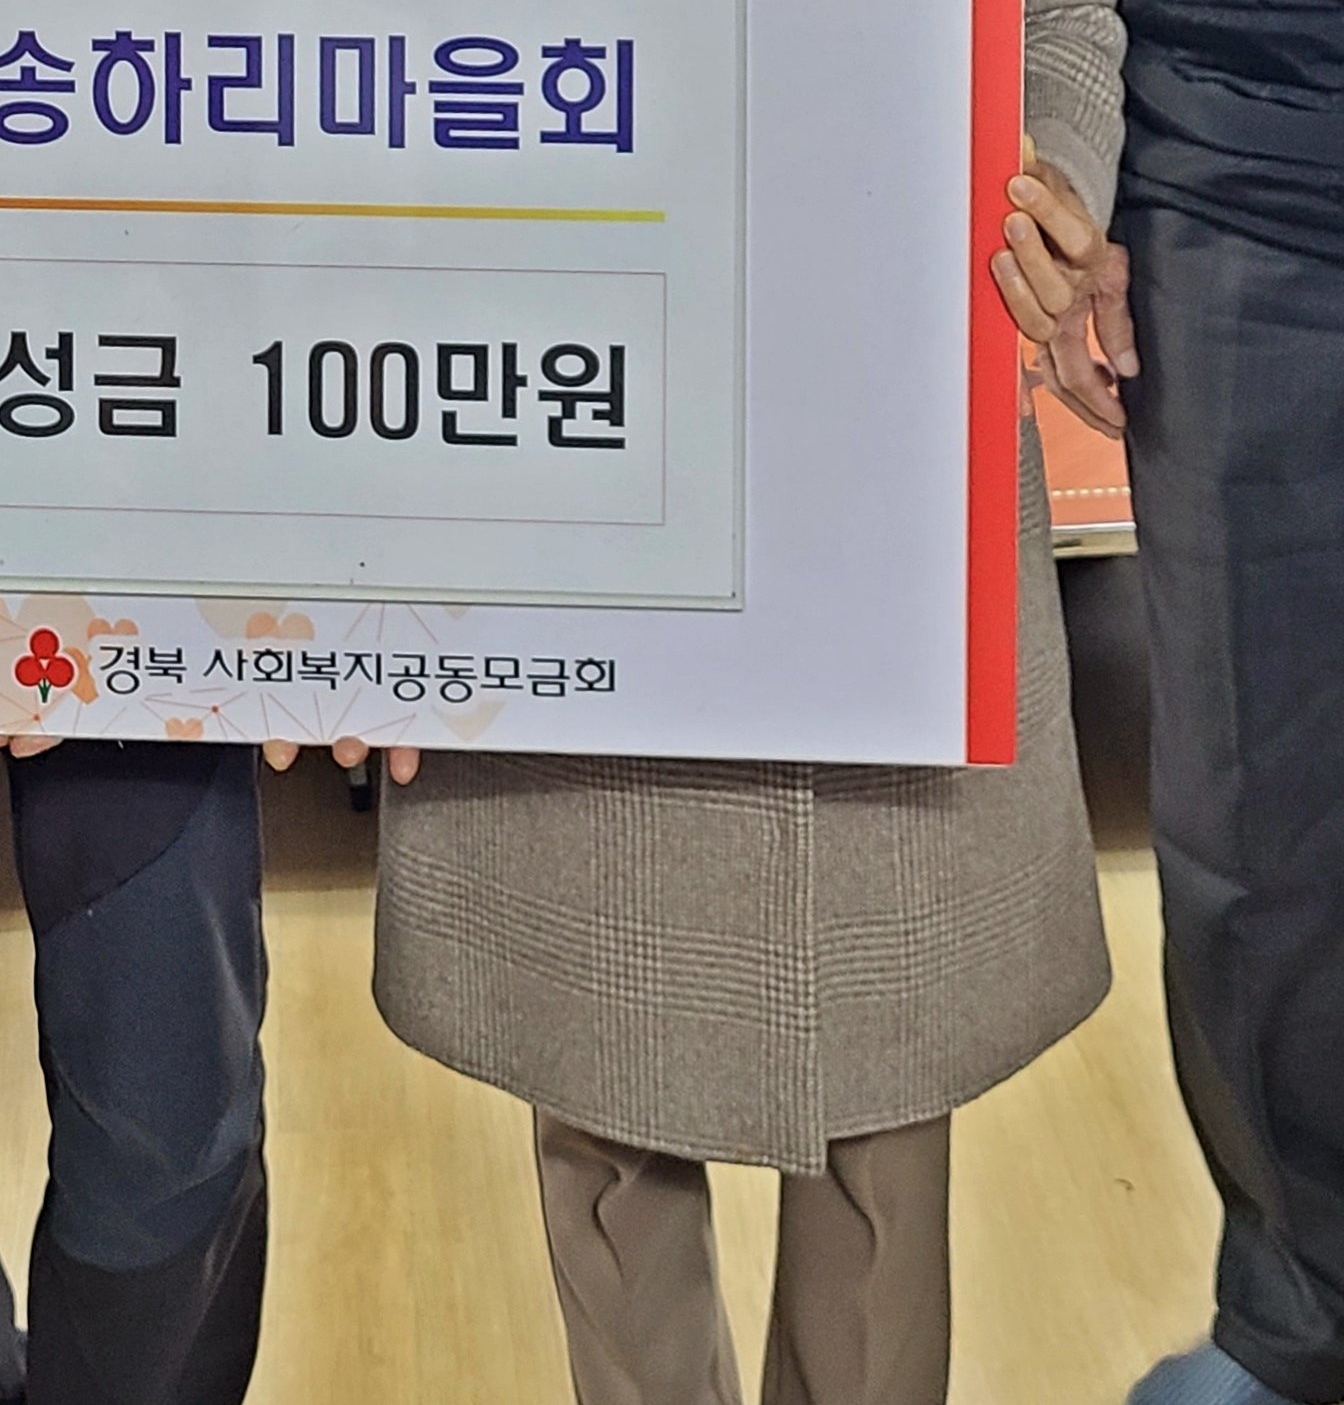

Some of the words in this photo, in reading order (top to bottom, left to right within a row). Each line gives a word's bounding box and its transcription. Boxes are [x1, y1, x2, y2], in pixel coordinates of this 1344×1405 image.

[252, 340, 626, 450] 100만원
[99, 645, 187, 695] 경북
[203, 647, 616, 704] 사회복지공동모금회
